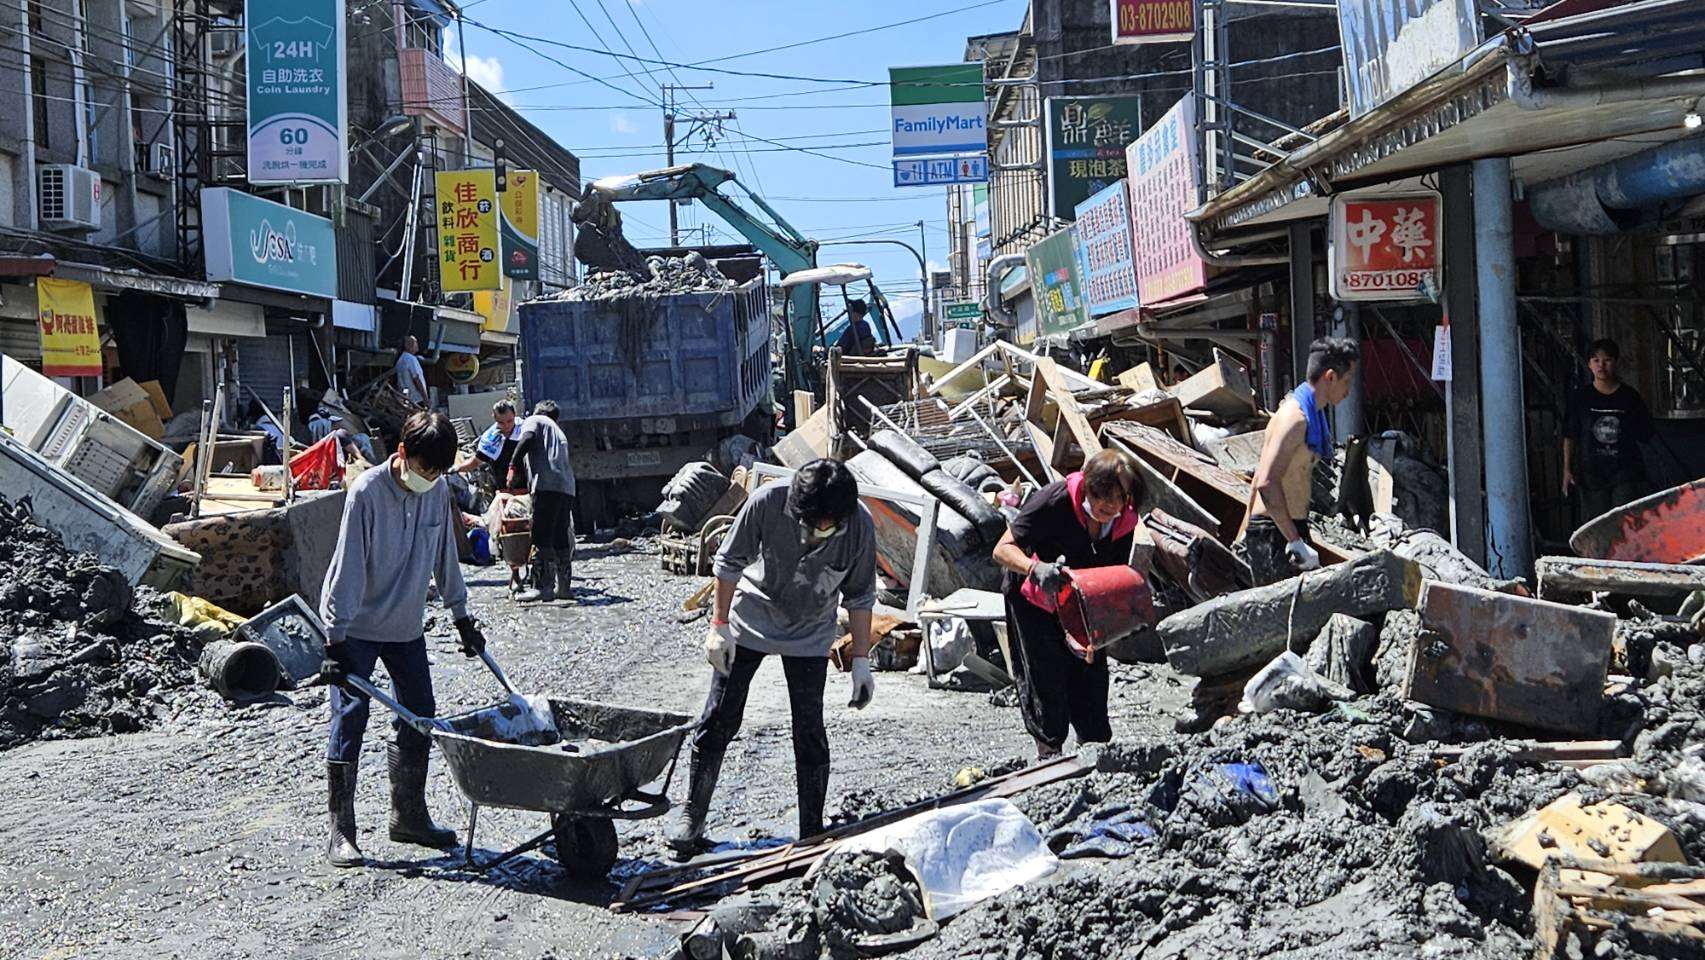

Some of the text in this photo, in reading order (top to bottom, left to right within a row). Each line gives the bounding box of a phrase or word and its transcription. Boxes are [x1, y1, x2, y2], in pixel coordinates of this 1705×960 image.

[1120, 1, 1191, 31] 03-8702908
[274, 41, 313, 58] 24H
[262, 68, 324, 83] 自助洗衣
[257, 85, 331, 95] Coin Laundry
[895, 115, 982, 134] FamilyMart
[280, 128, 309, 145] 60
[930, 161, 953, 180] ATM
[1068, 159, 1127, 178] 現泡茶
[442, 201, 454, 229] 飲料
[454, 182, 482, 281] 佳欣商行
[1347, 207, 1432, 265] 中藥
